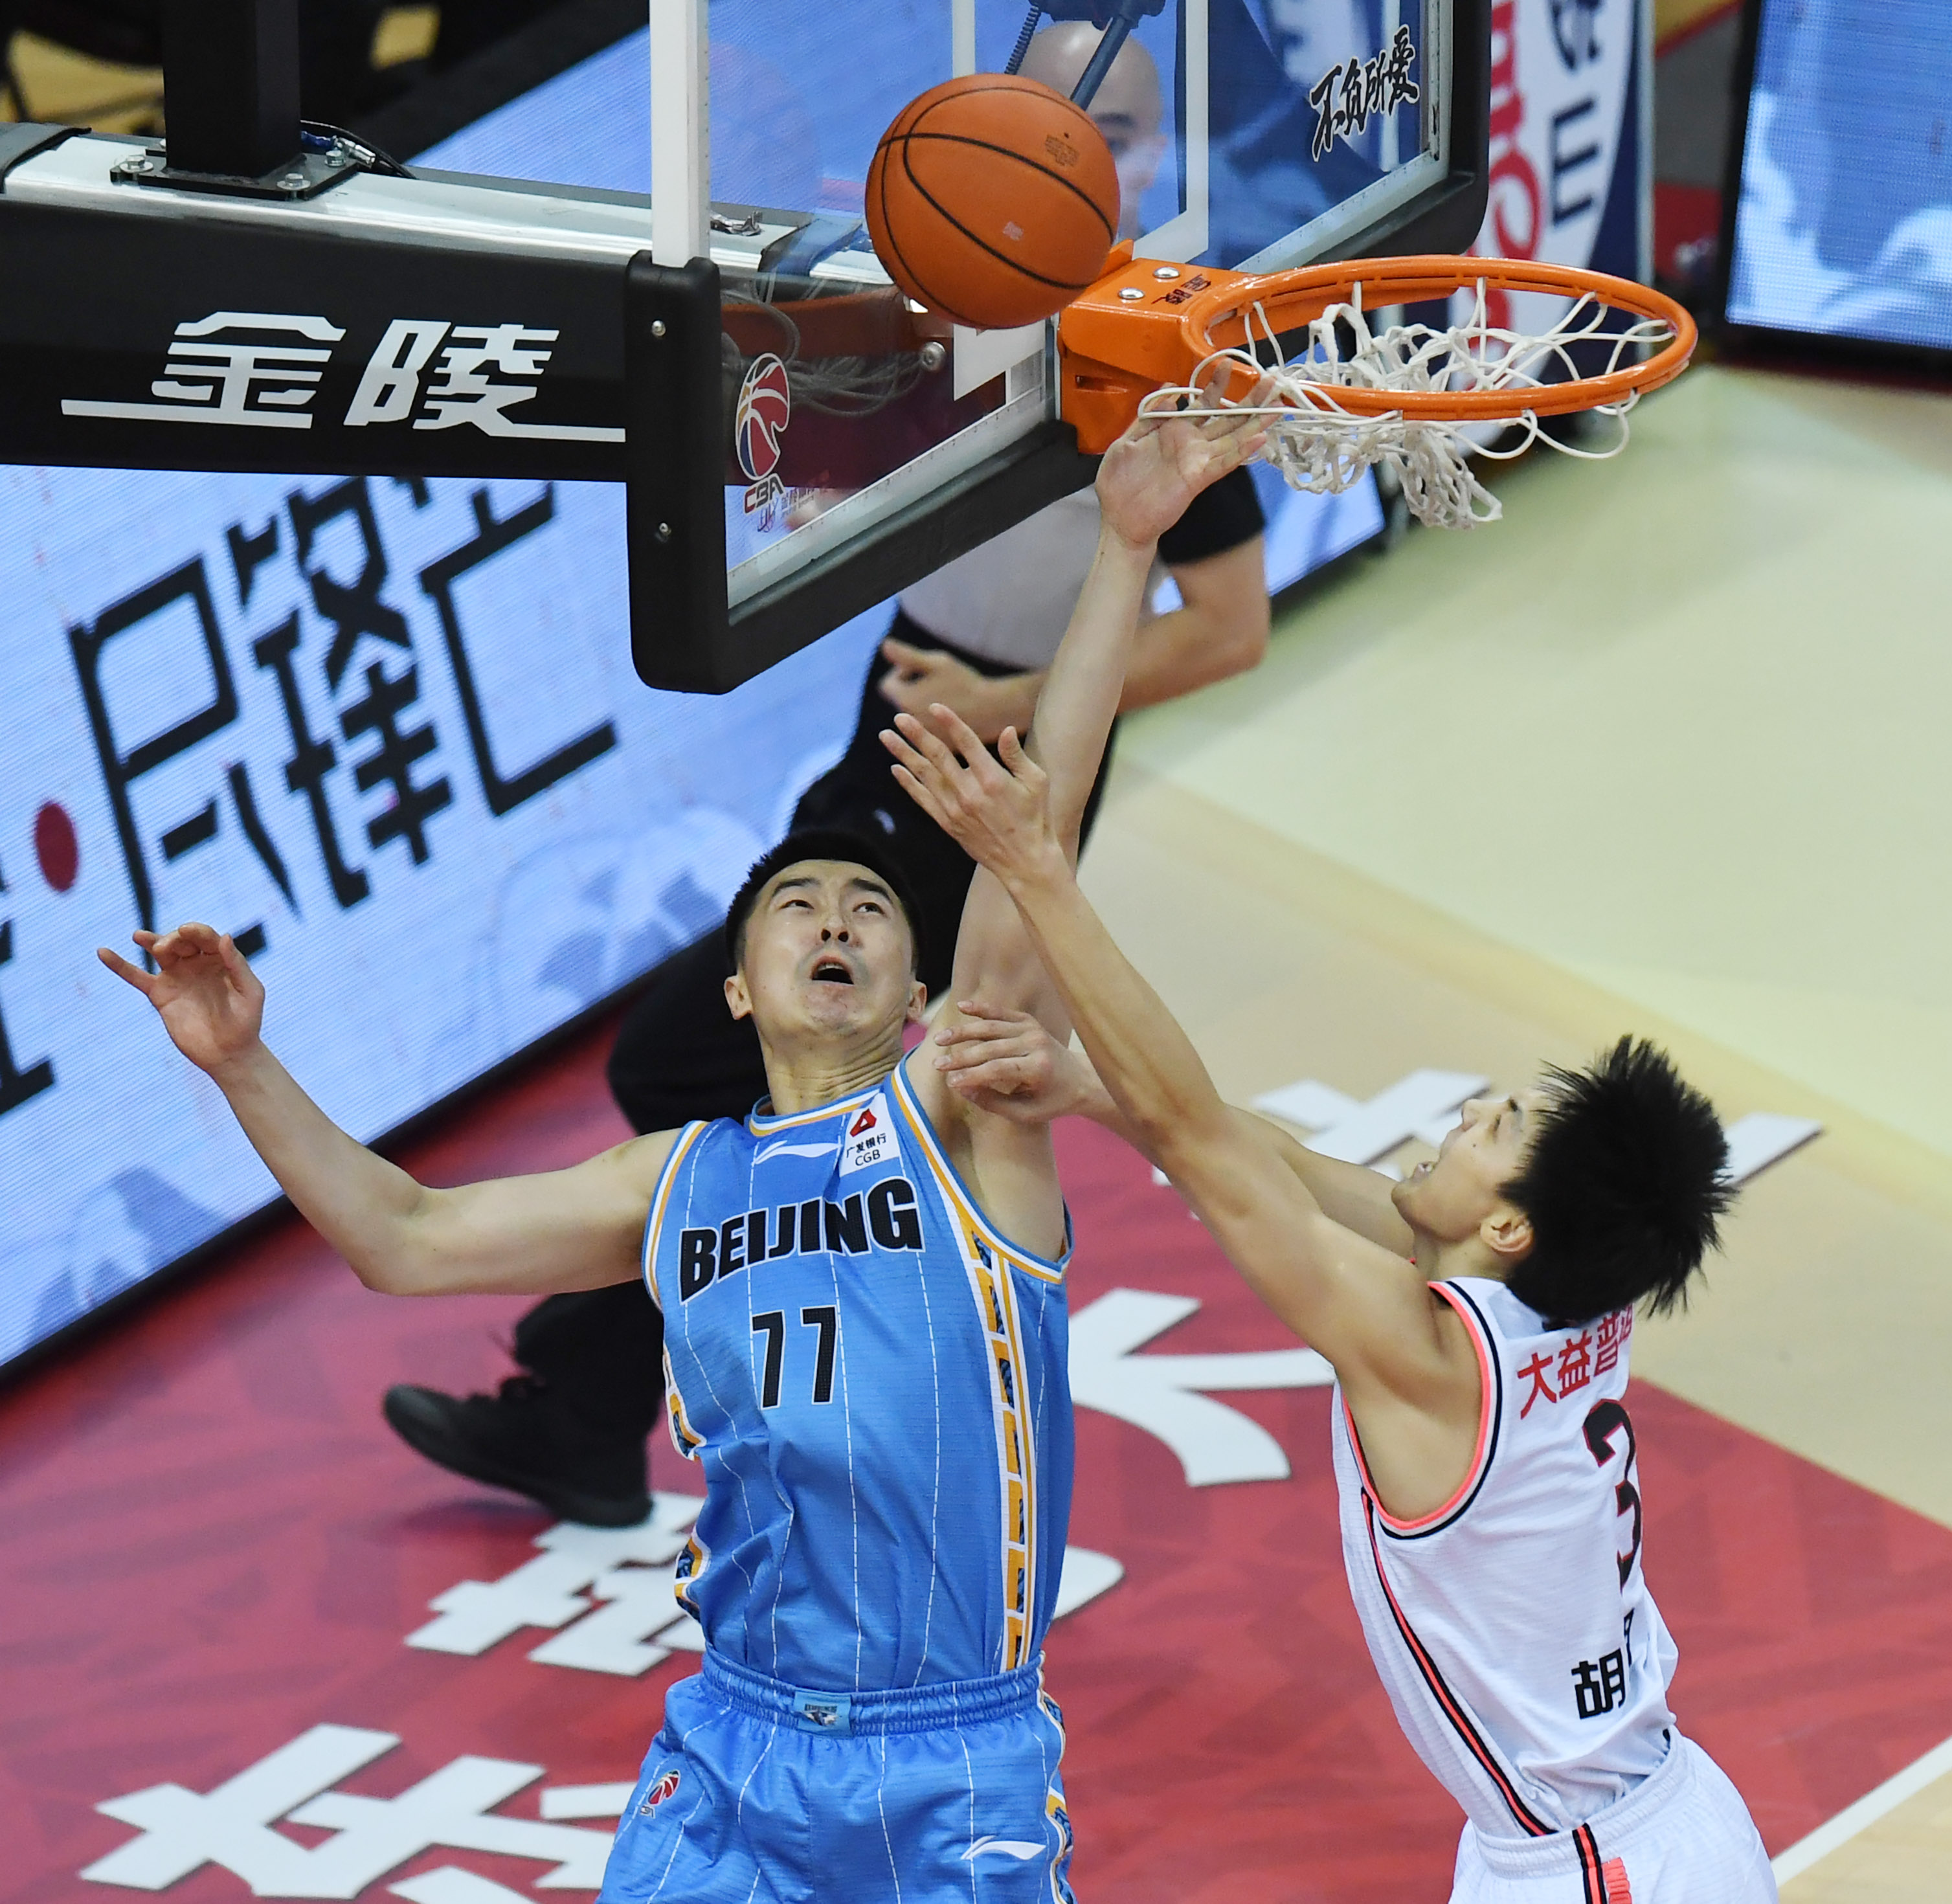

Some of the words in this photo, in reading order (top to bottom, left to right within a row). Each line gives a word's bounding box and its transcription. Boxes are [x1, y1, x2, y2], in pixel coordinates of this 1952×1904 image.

[1310, 24, 1419, 162] 不负所爱
[62, 311, 625, 442] 金陵
[745, 473, 785, 514] CBA
[846, 1133, 886, 1158] 广发银行
[855, 1149, 881, 1166] CGB
[680, 1176, 925, 1304] BEIJING
[752, 1305, 838, 1409] 77
[1571, 1607, 1635, 1719] 胡
